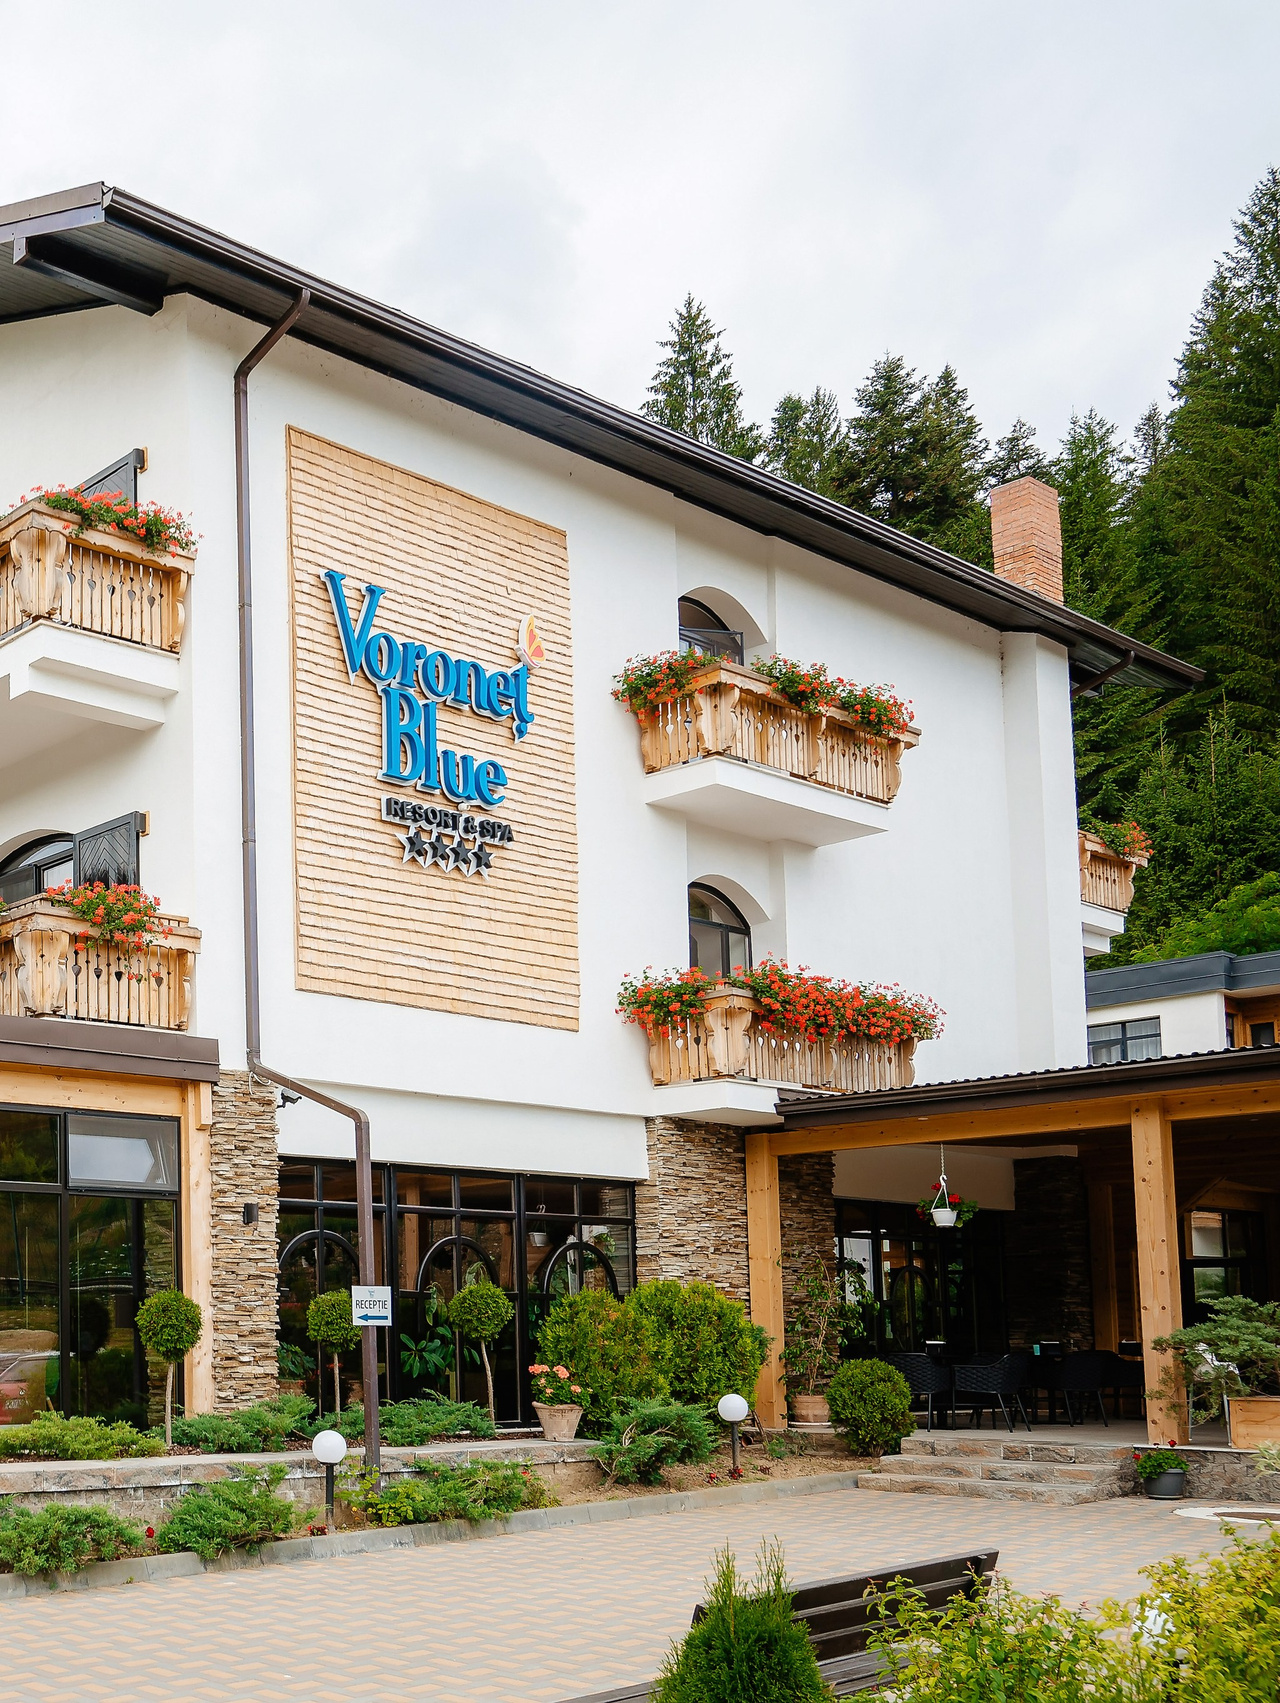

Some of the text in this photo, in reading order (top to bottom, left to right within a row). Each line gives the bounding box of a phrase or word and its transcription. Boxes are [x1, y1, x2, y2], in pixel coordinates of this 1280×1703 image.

[379, 686, 508, 806] Blue
[385, 796, 515, 843] RESORT & SPA
